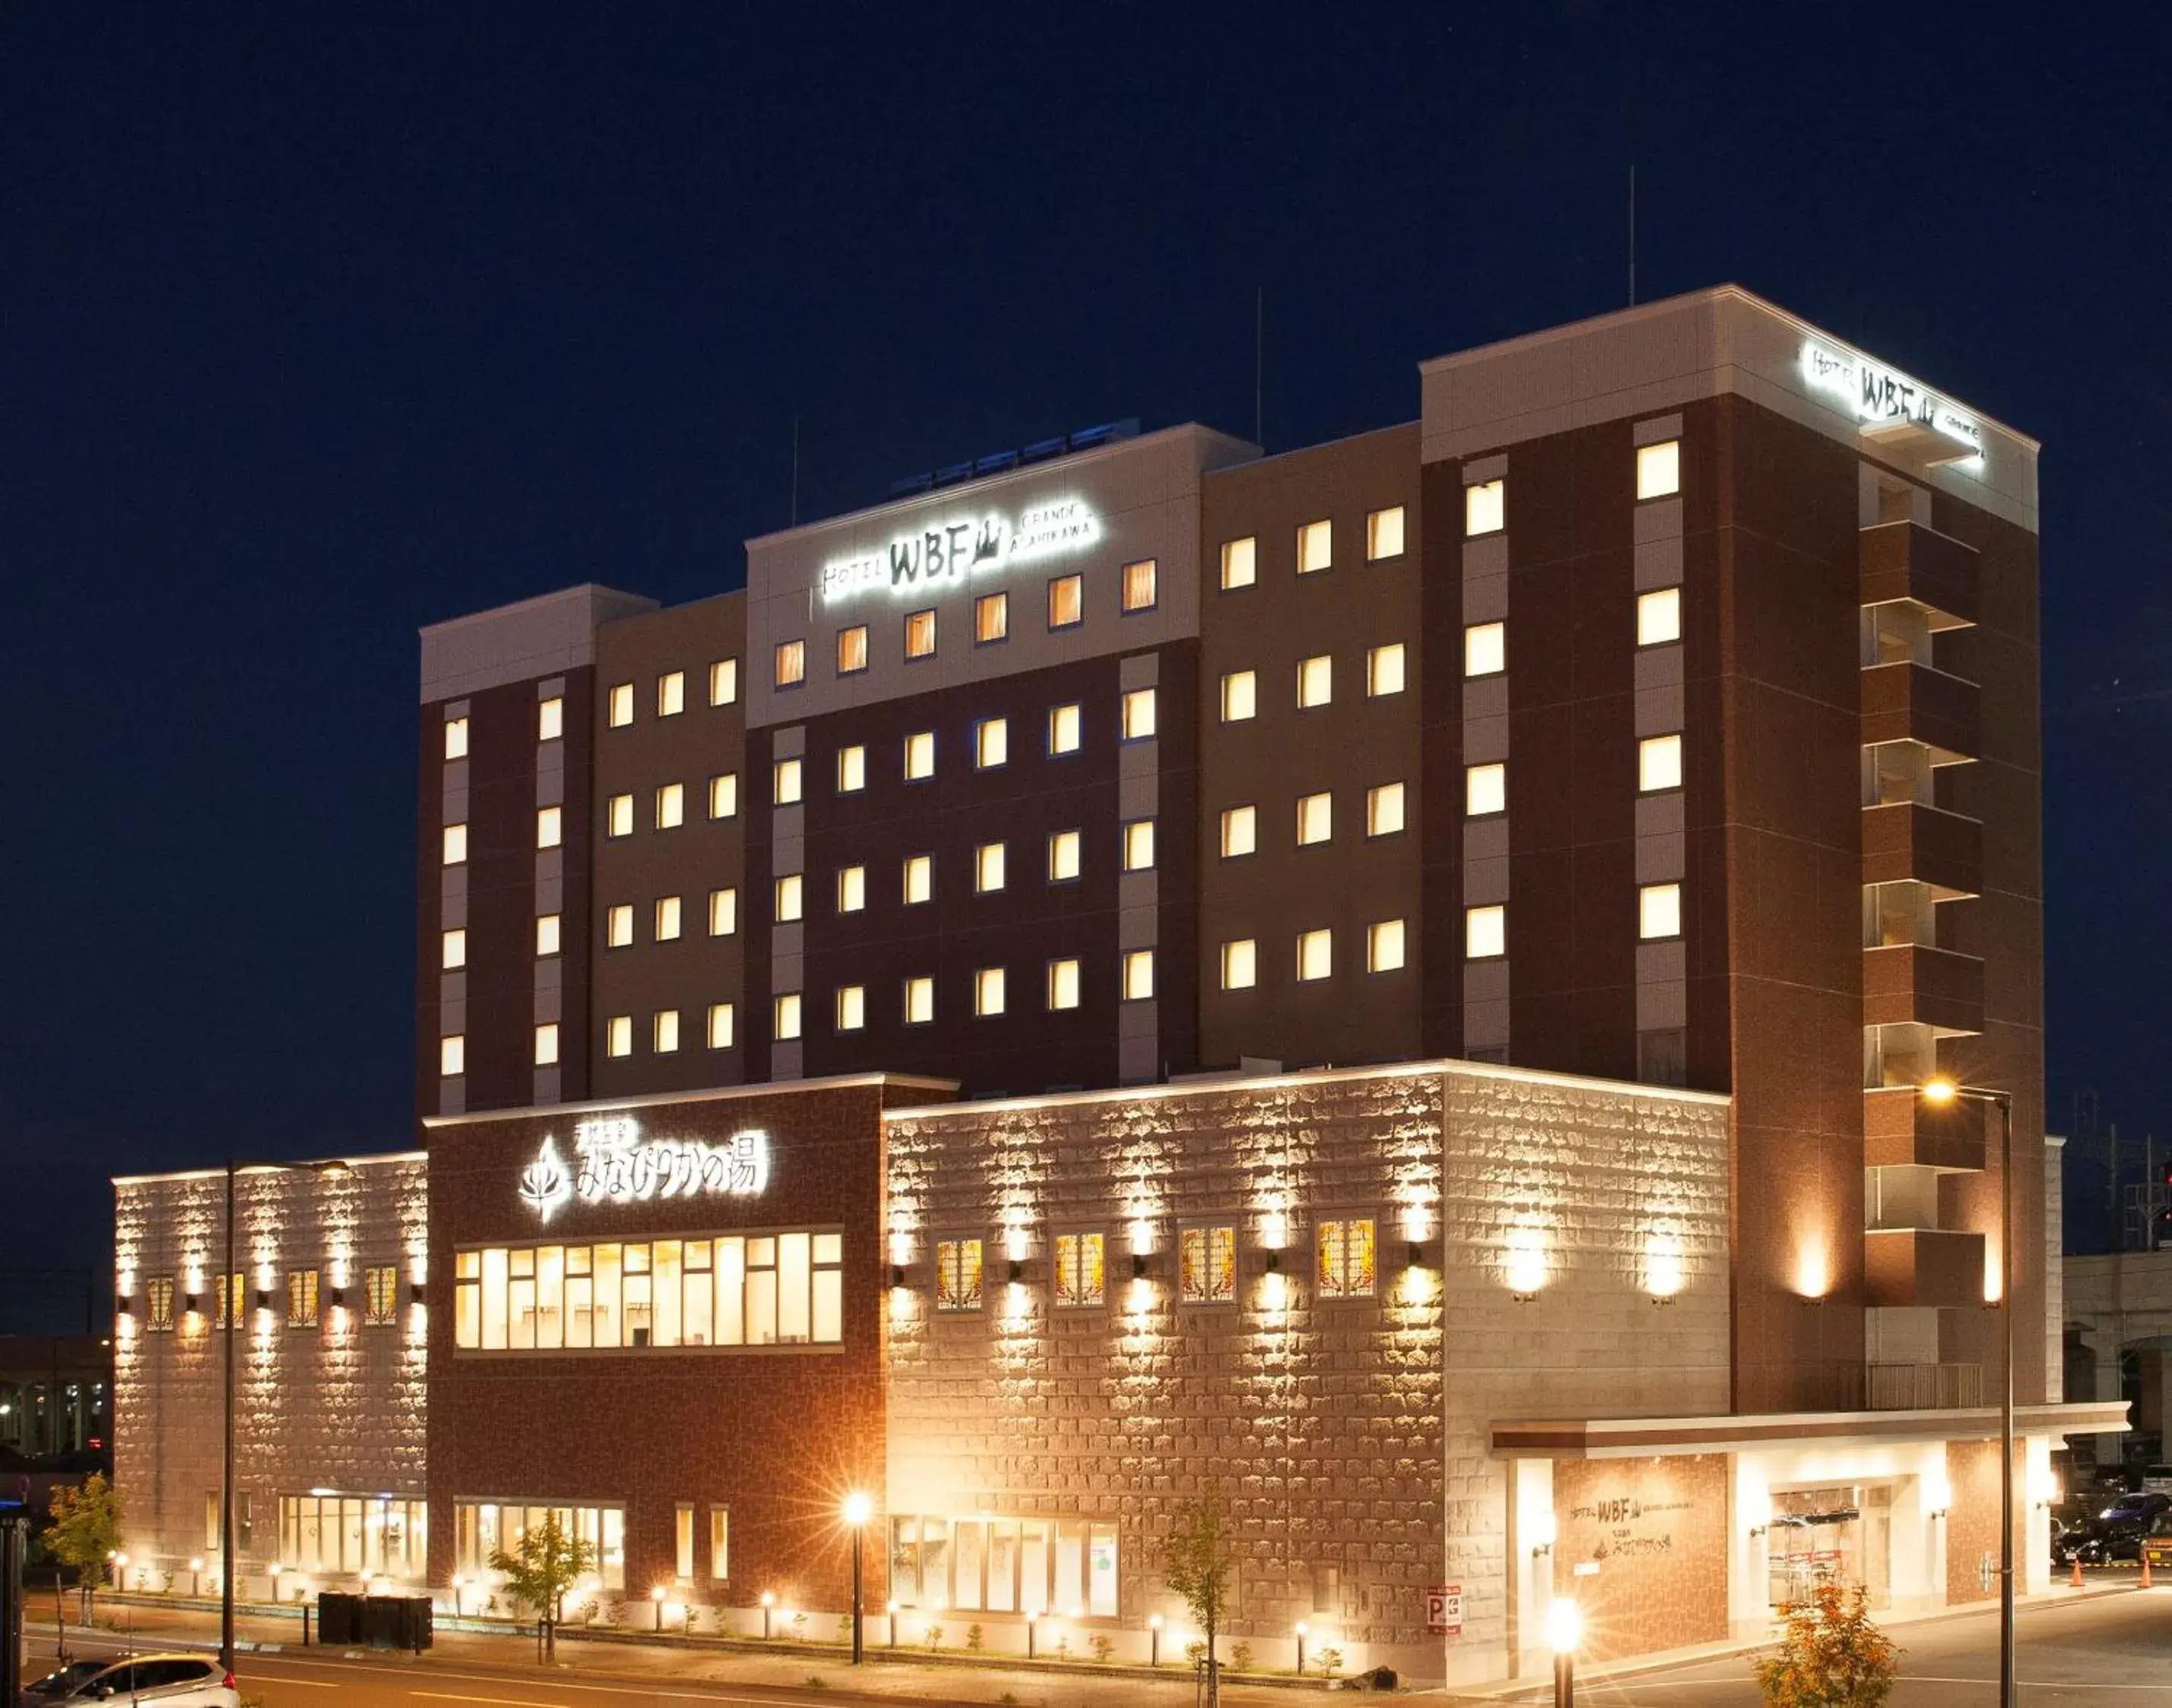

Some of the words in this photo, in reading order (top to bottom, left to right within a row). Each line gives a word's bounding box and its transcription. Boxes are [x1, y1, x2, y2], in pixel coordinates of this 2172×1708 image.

[1862, 366, 1915, 421] WBF
[823, 558, 883, 595] HOTEL
[890, 524, 970, 585] WBF
[1598, 1497, 1630, 1524] WBF
[1431, 1598, 1443, 1621] P
